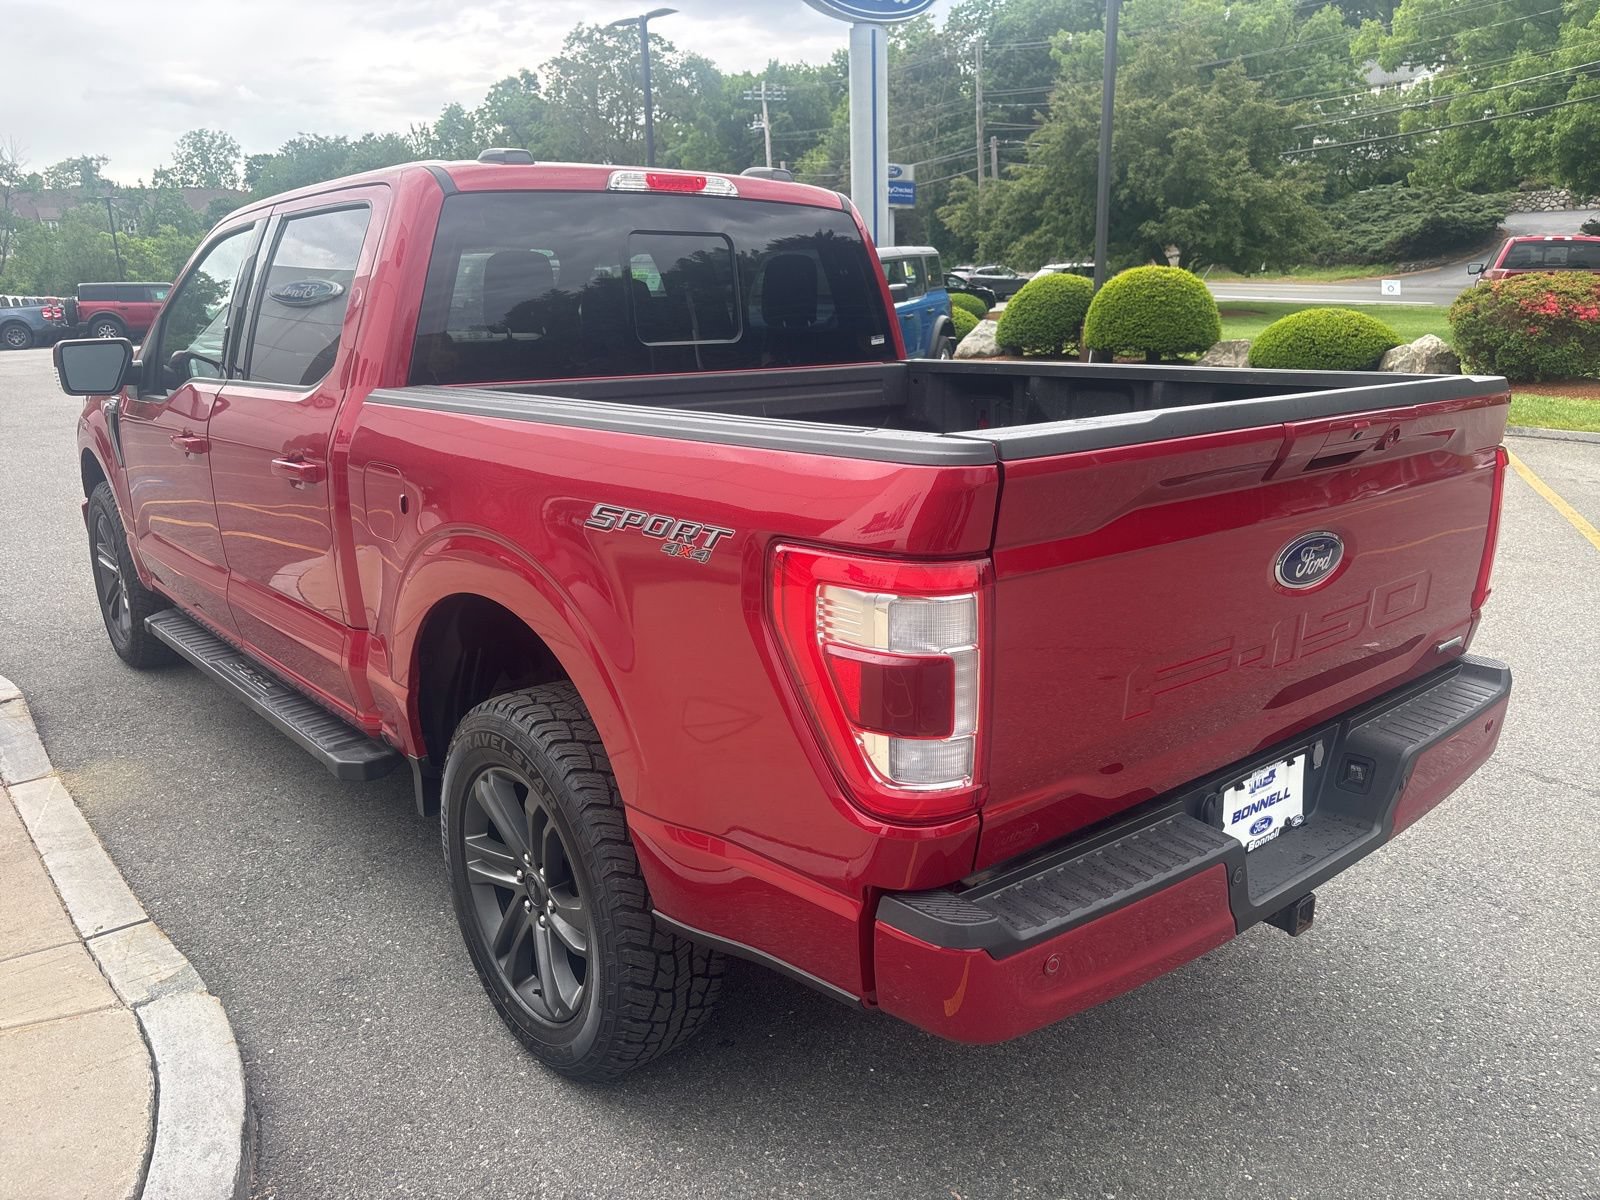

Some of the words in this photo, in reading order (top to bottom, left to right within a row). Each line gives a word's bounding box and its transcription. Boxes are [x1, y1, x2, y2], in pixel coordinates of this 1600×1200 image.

[583, 503, 736, 550] SPORT
[1295, 543, 1333, 579] Ford
[1122, 570, 1431, 720] F-150
[1231, 787, 1290, 825] BONNELL
[1247, 827, 1280, 852] Bonnell
